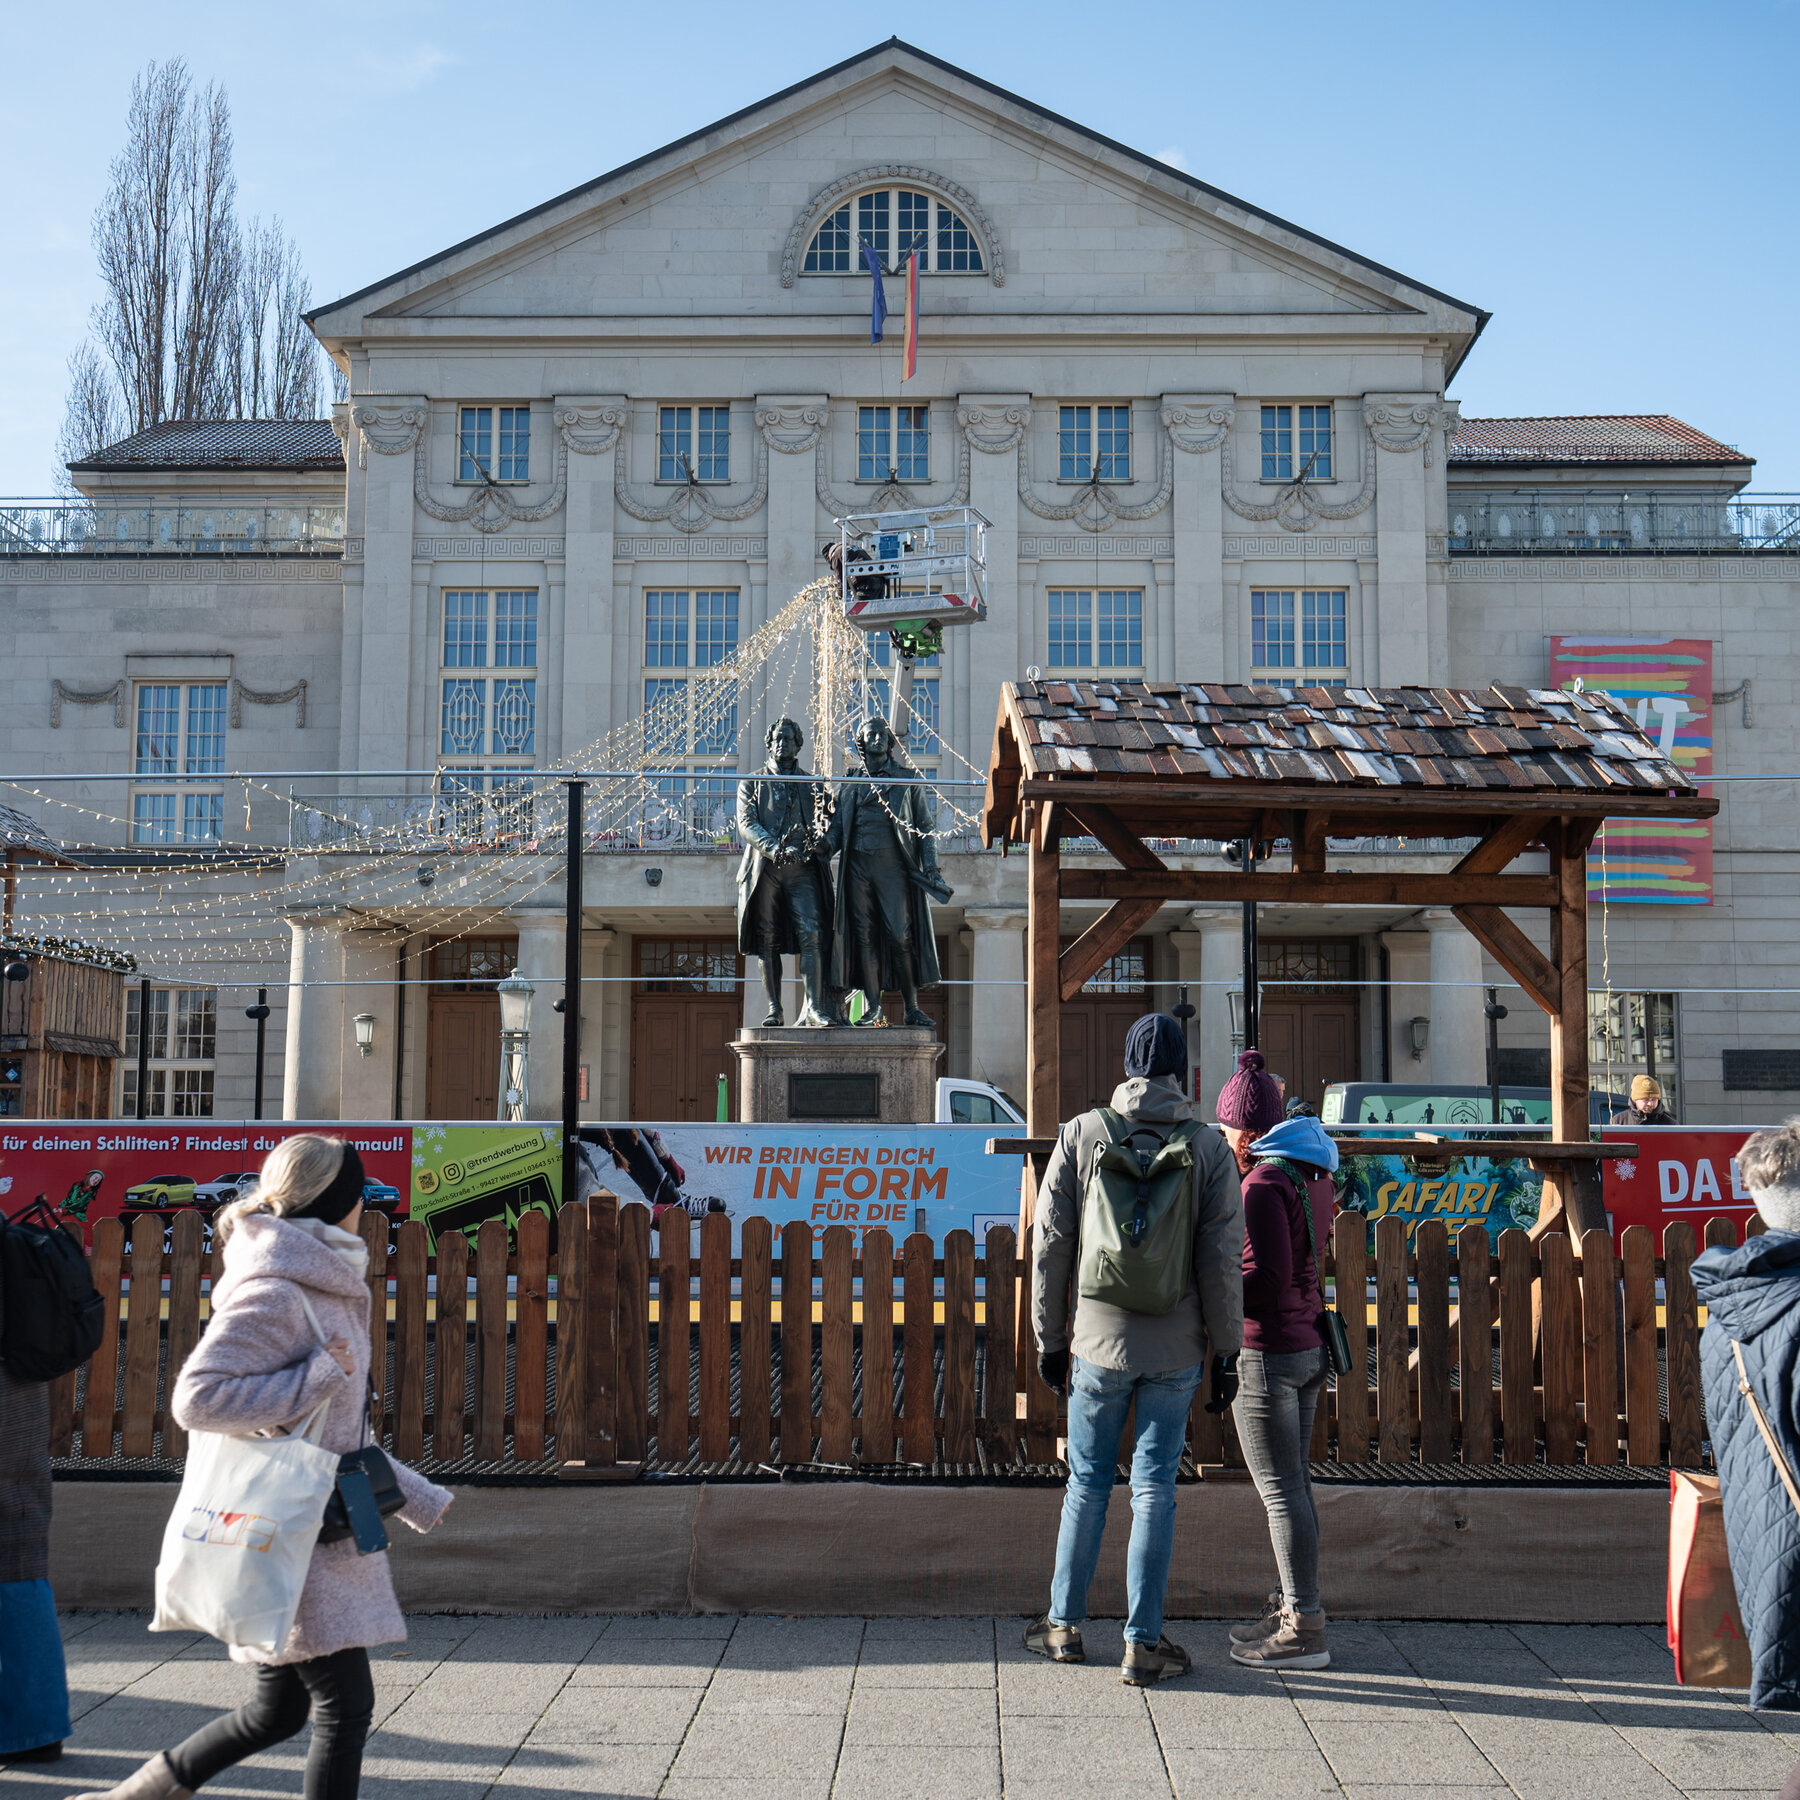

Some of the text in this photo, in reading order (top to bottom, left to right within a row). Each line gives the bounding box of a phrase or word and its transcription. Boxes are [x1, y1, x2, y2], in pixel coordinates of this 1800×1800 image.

[2, 1135, 28, 1150] für
[32, 1135, 92, 1151] deinen
[96, 1135, 180, 1151] Schlitten?
[185, 1135, 248, 1151] Findest
[253, 1135, 276, 1151] du
[467, 1138, 538, 1170] @trendwerbung
[704, 1146, 935, 1165] WIR BRINGEN DICH
[412, 1187, 471, 1212] Otto-Schott-Straße
[480, 1177, 498, 1189] 99427
[499, 1169, 523, 1182] Weimar
[527, 1160, 547, 1172] 03643
[752, 1166, 949, 1201] IN FORM
[1658, 1158, 1722, 1203] DA
[810, 1198, 908, 1221] FÜR DIE
[1367, 1181, 1500, 1221] SAFARI
